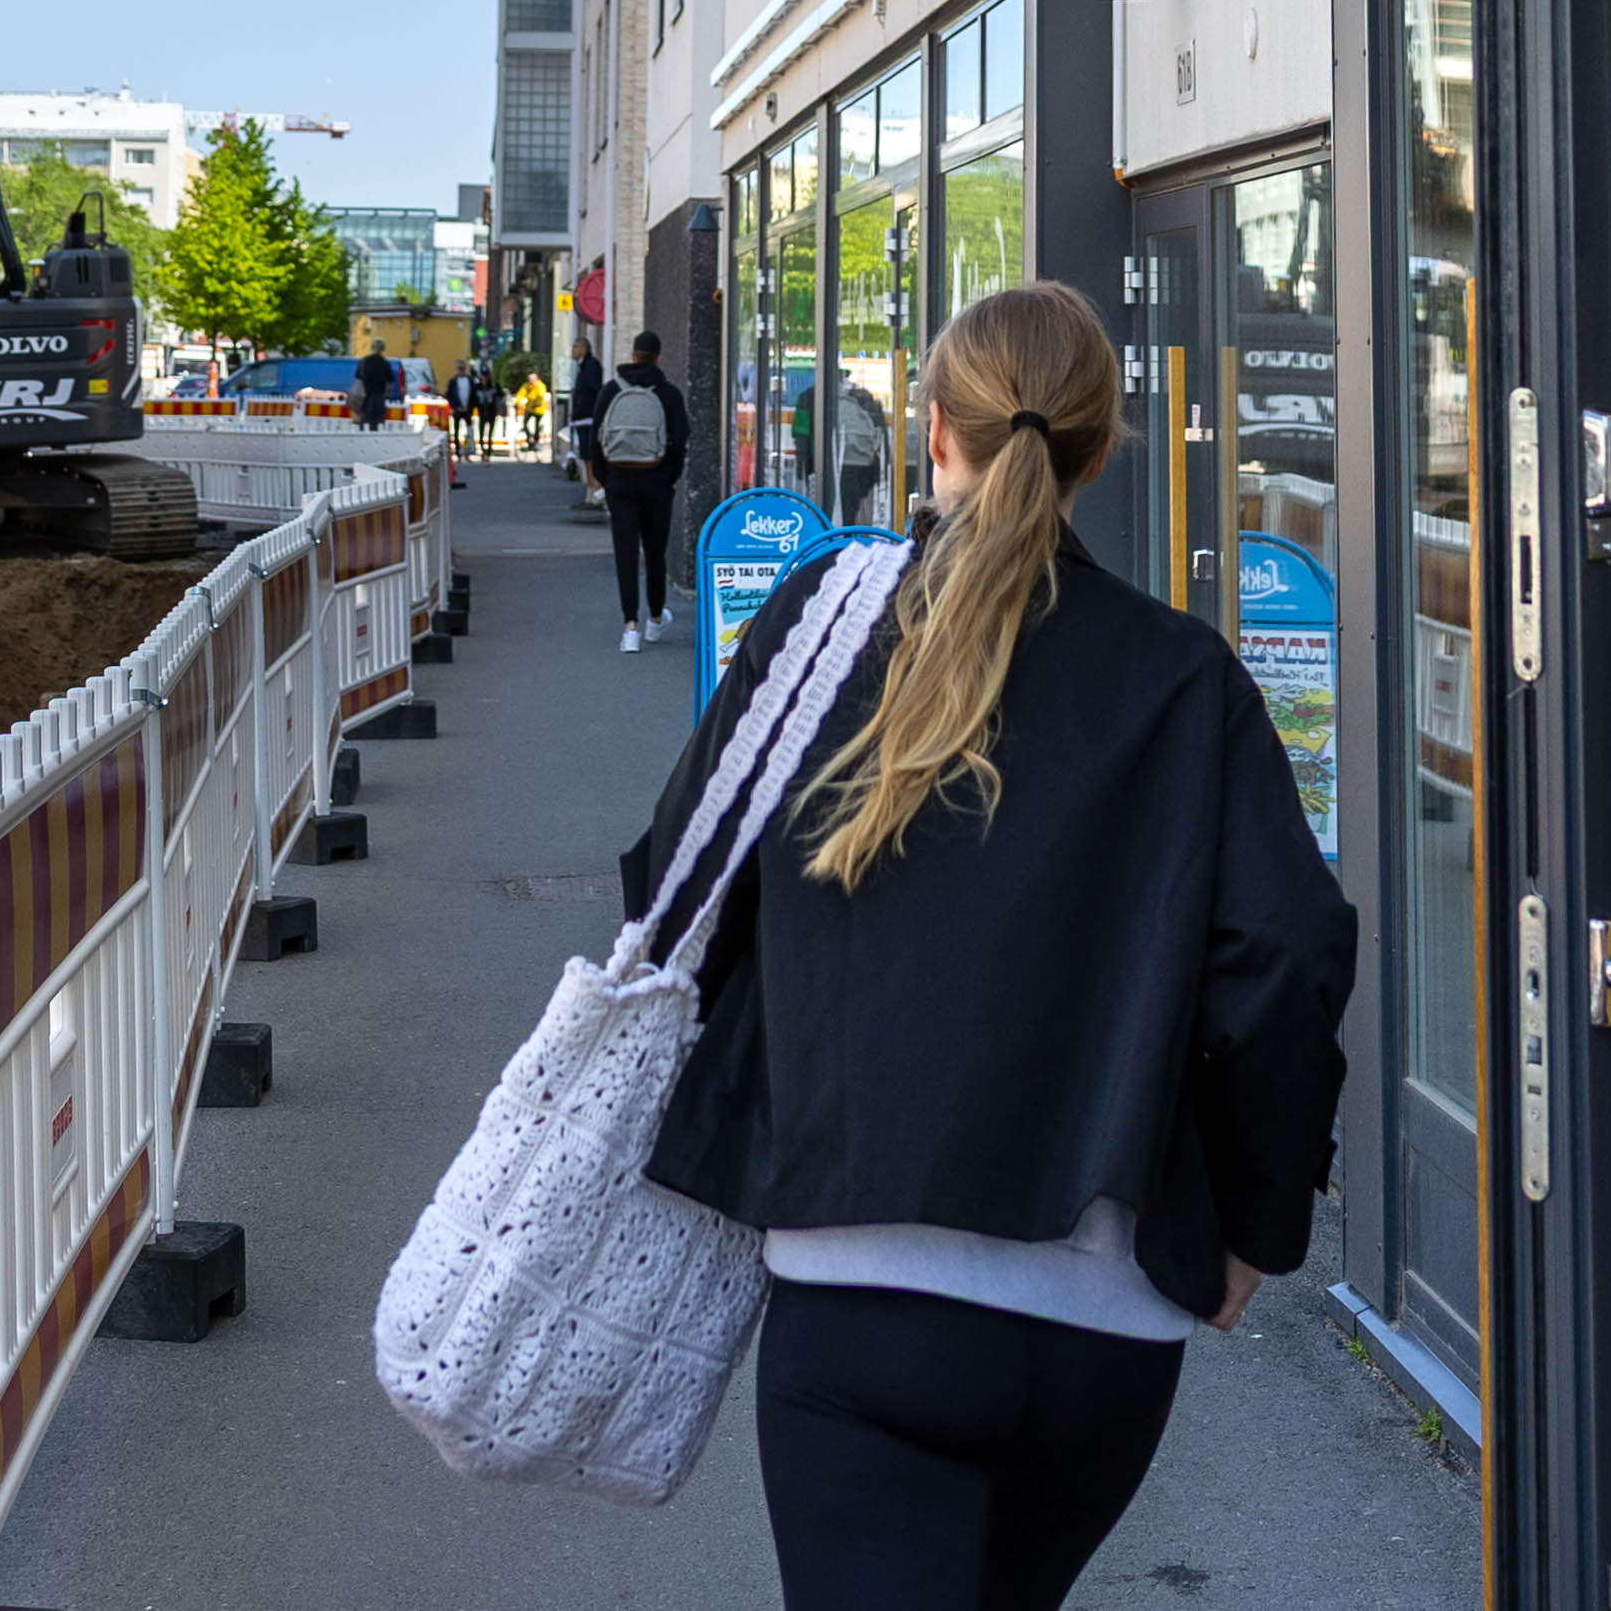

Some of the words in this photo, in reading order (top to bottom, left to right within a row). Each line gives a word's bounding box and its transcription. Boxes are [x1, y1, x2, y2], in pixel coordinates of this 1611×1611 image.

[740, 510, 804, 542] Lekker
[717, 564, 735, 578] SYÖ
[739, 566, 754, 578] TAI
[757, 566, 777, 578] OTA
